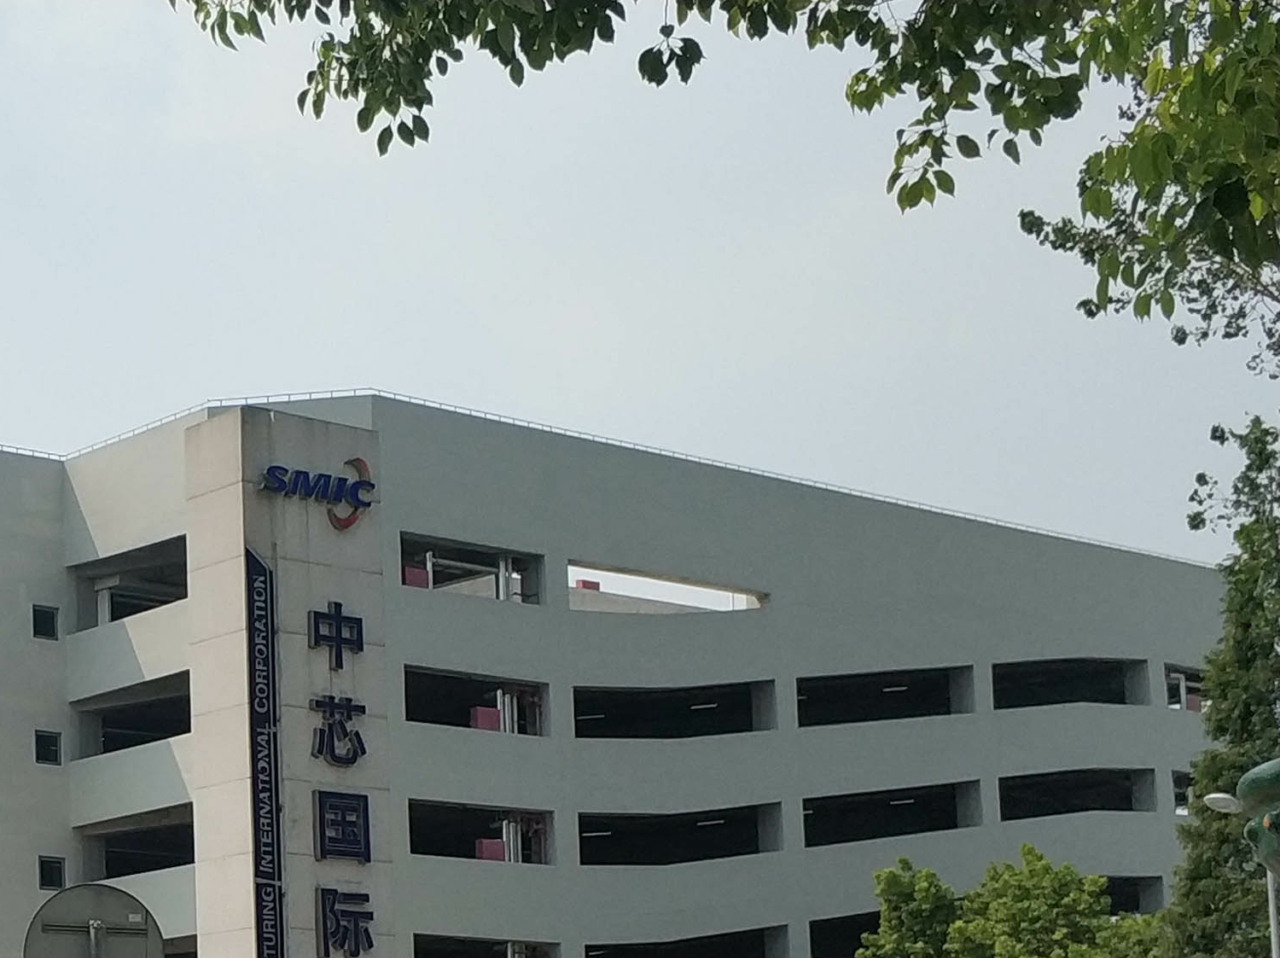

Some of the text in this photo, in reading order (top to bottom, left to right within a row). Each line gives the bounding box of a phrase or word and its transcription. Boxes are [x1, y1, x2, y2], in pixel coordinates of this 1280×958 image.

[263, 465, 376, 508] SMIC
[253, 575, 268, 713] CORPORATION
[256, 722, 274, 874] INTERNATIONAL
[309, 602, 374, 958] 中芯国际
